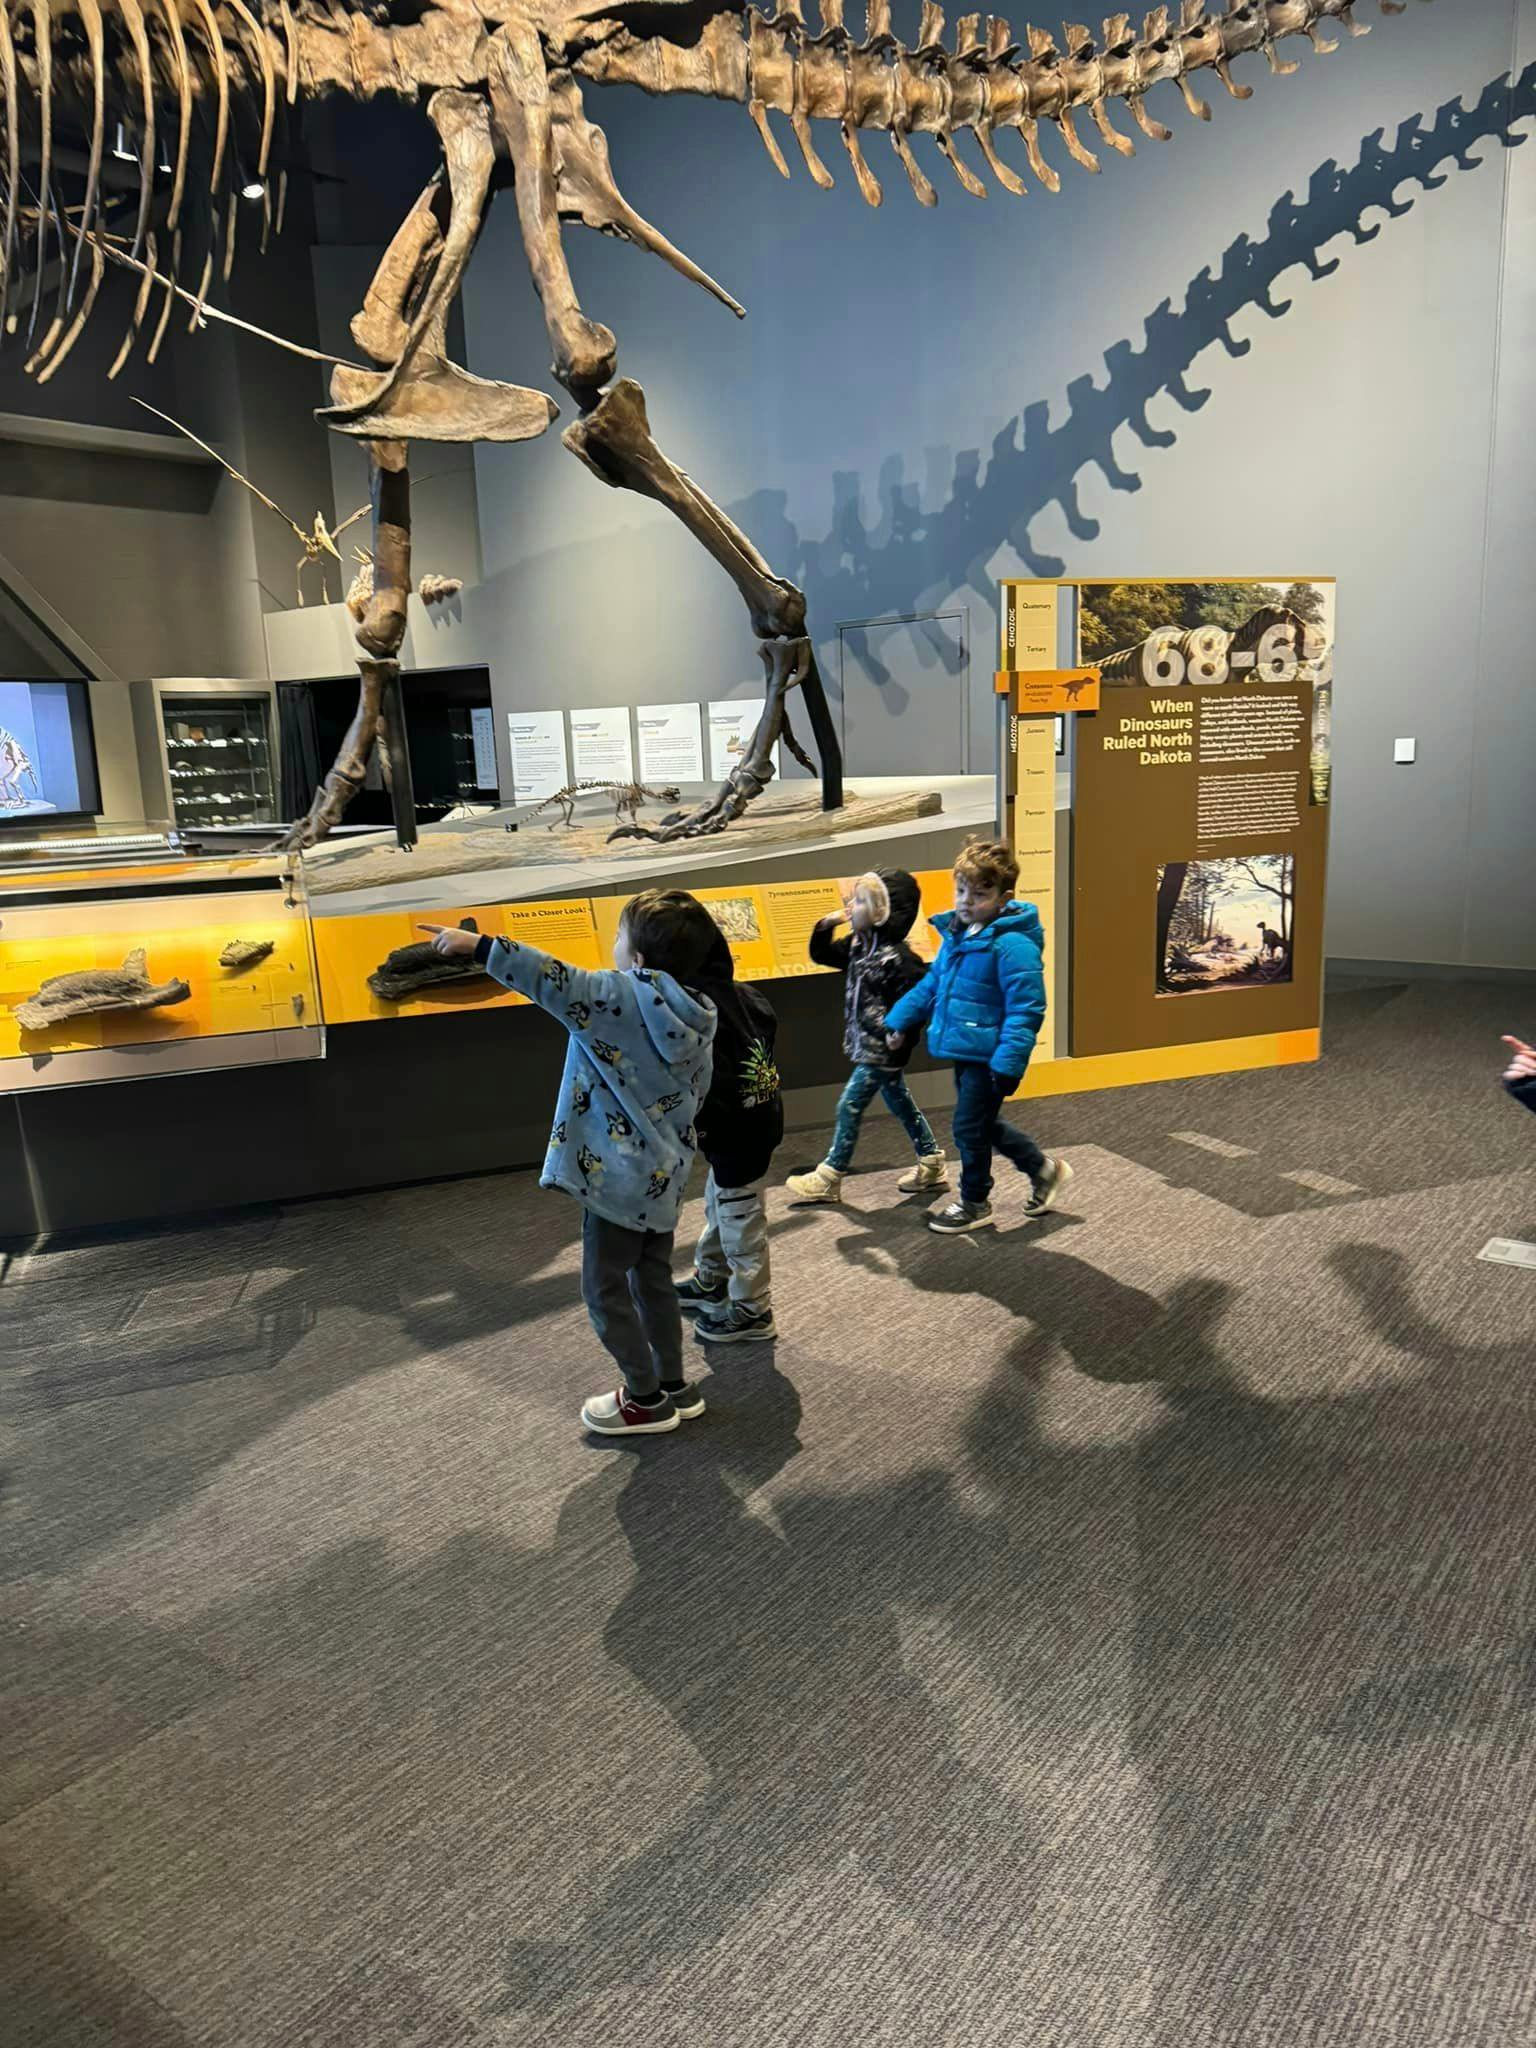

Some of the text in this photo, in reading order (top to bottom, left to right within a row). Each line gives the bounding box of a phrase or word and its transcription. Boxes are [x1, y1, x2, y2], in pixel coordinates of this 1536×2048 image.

[1150, 699, 1194, 714] When
[1120, 717, 1193, 732] Dinosaurs
[1103, 732, 1192, 750] Ruled North
[1140, 750, 1192, 765] Dakota
[511, 910, 530, 919] Take
[538, 908, 564, 917] Closer
